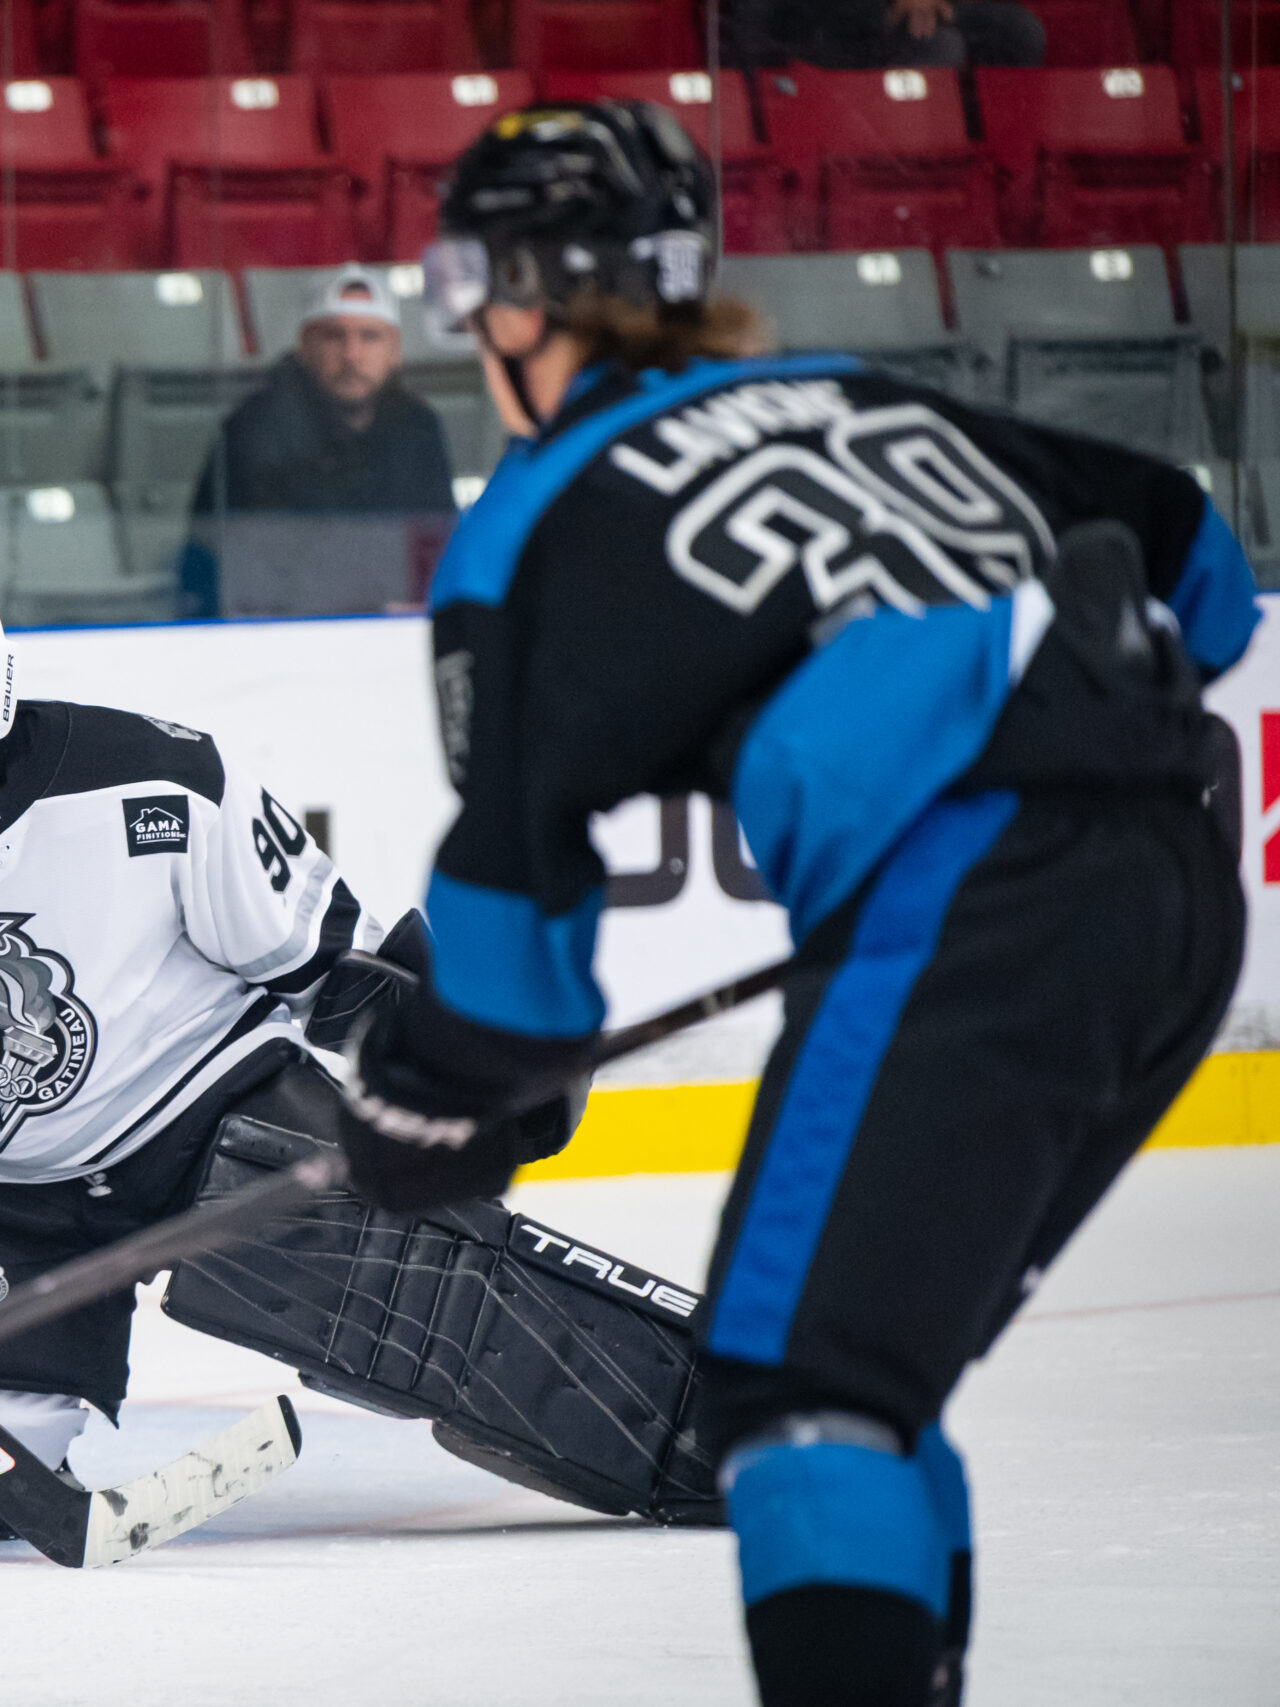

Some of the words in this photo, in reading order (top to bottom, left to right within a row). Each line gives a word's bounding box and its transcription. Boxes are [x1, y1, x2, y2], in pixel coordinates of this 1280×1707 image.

[135, 820, 180, 833] GAMA
[136, 831, 180, 841] FINITIONS
[251, 784, 308, 895] 90
[37, 1007, 85, 1101] GATINEAU
[521, 1224, 699, 1318] TRUE
